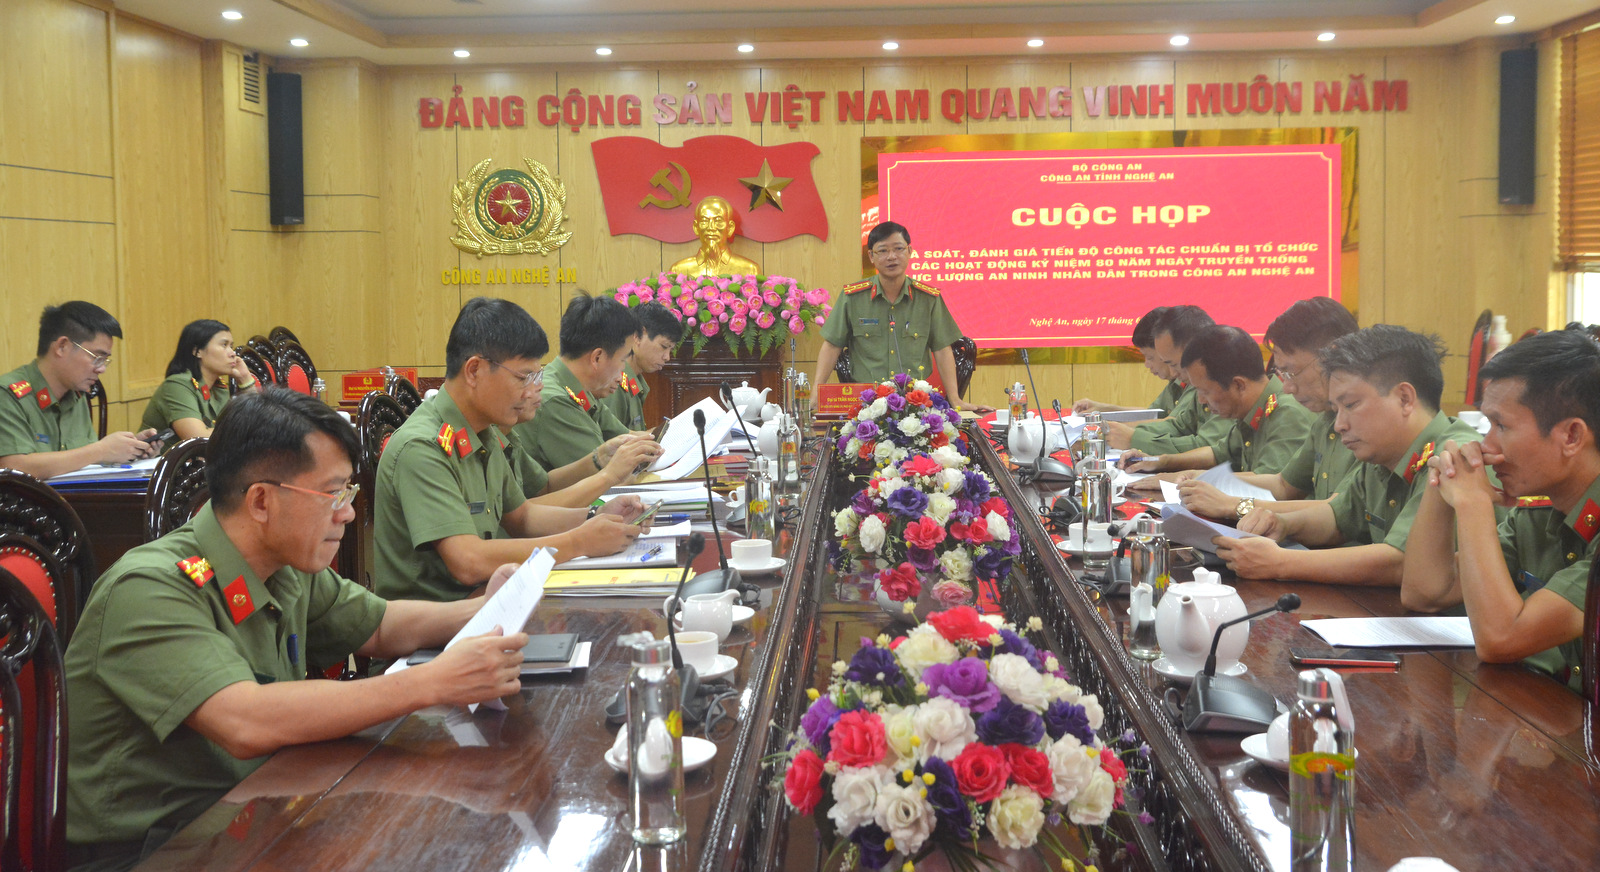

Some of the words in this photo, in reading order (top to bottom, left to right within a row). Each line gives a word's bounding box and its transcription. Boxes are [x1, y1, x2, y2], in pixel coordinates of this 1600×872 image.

[419, 84, 525, 128] ĐẢNG
[537, 88, 642, 133] CỘNG
[652, 80, 733, 124] SẢN
[745, 84, 826, 128] VIỆT
[837, 89, 930, 121] NAM
[940, 86, 1072, 123] QUANG
[1083, 84, 1174, 116] VINH
[1187, 74, 1302, 114] MUÔN
[1313, 73, 1408, 112] NĂM
[1072, 163, 1088, 172] BỘ
[1092, 163, 1123, 171] CÔNG
[1127, 163, 1142, 171] AN
[1040, 174, 1072, 182] CÔNG
[1075, 173, 1091, 181] AN
[1124, 171, 1156, 182] NGHỆ
[1158, 172, 1174, 180] AN
[1012, 203, 1116, 229] CUỘC
[1133, 205, 1210, 227] HỌP
[924, 249, 964, 258] SOÁT,
[969, 248, 1008, 257] ĐÁNH
[1014, 247, 1037, 256] GIÁ
[1042, 246, 1073, 256] TIẾN
[1078, 246, 1098, 256] ĐỘ
[1104, 246, 1143, 255] CÔNG
[1148, 245, 1175, 254] TÁC
[1235, 245, 1249, 254] BỊ
[1277, 242, 1318, 252] CHỨC
[911, 261, 939, 270] CÁC
[945, 262, 983, 270] HOẠT
[987, 260, 1026, 270] ĐỘNG
[1054, 258, 1090, 268] NIỆM
[1096, 259, 1113, 267] 80
[1119, 257, 1151, 266] NĂM
[1259, 254, 1307, 264] THỐNG
[441, 266, 481, 285] CÔNG
[486, 268, 507, 285] AN
[511, 265, 550, 287] NGHỆ
[556, 267, 577, 284] AN
[937, 273, 984, 282] LƯỢNG
[1053, 270, 1091, 279] NHÂN
[1097, 269, 1125, 278] DÂN
[1183, 268, 1222, 277] CÔNG
[1252, 266, 1290, 276] NGHỆ
[1295, 267, 1314, 275] AN
[1029, 318, 1053, 327] Nghệ
[1054, 318, 1069, 326] An,
[1108, 317, 1133, 325] tháng
